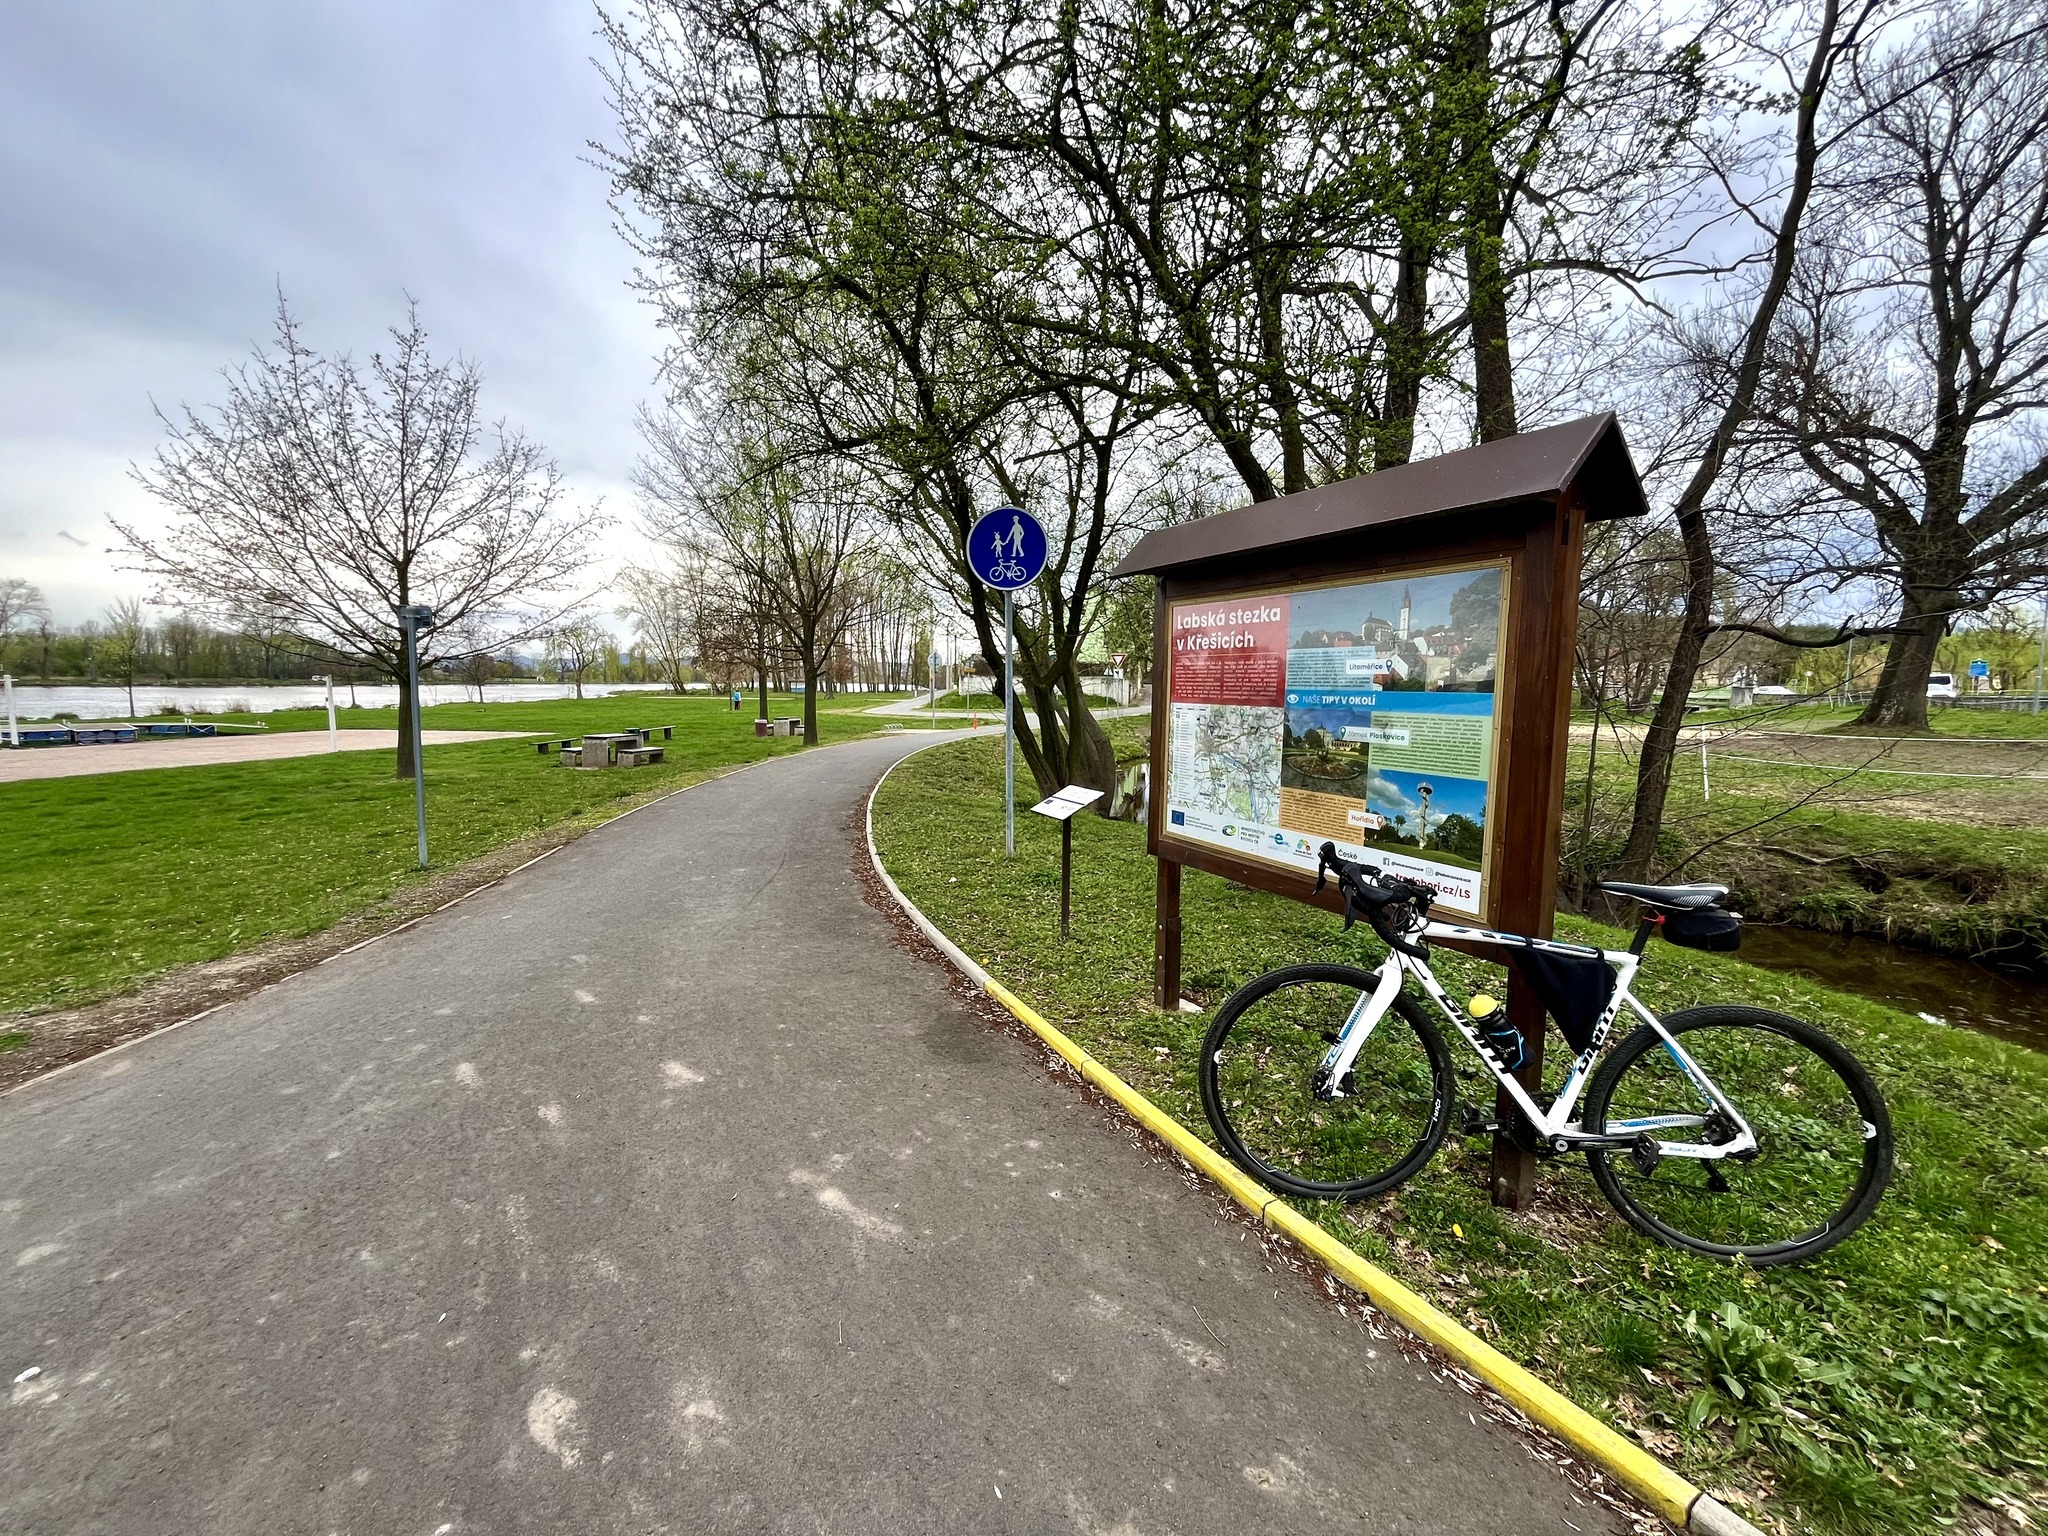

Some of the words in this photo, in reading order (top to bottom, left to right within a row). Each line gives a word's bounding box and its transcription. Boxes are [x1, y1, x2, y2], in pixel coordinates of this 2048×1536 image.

[1177, 608, 1225, 629] Labská
[1229, 605, 1281, 625] stezka
[1176, 639, 1184, 651] v
[1187, 630, 1254, 651] Křešicích
[1321, 695, 1340, 705] TIPY
[1340, 696, 1350, 705] V
[1350, 694, 1376, 706] OKOLÍ
[1338, 848, 1358, 860] České
